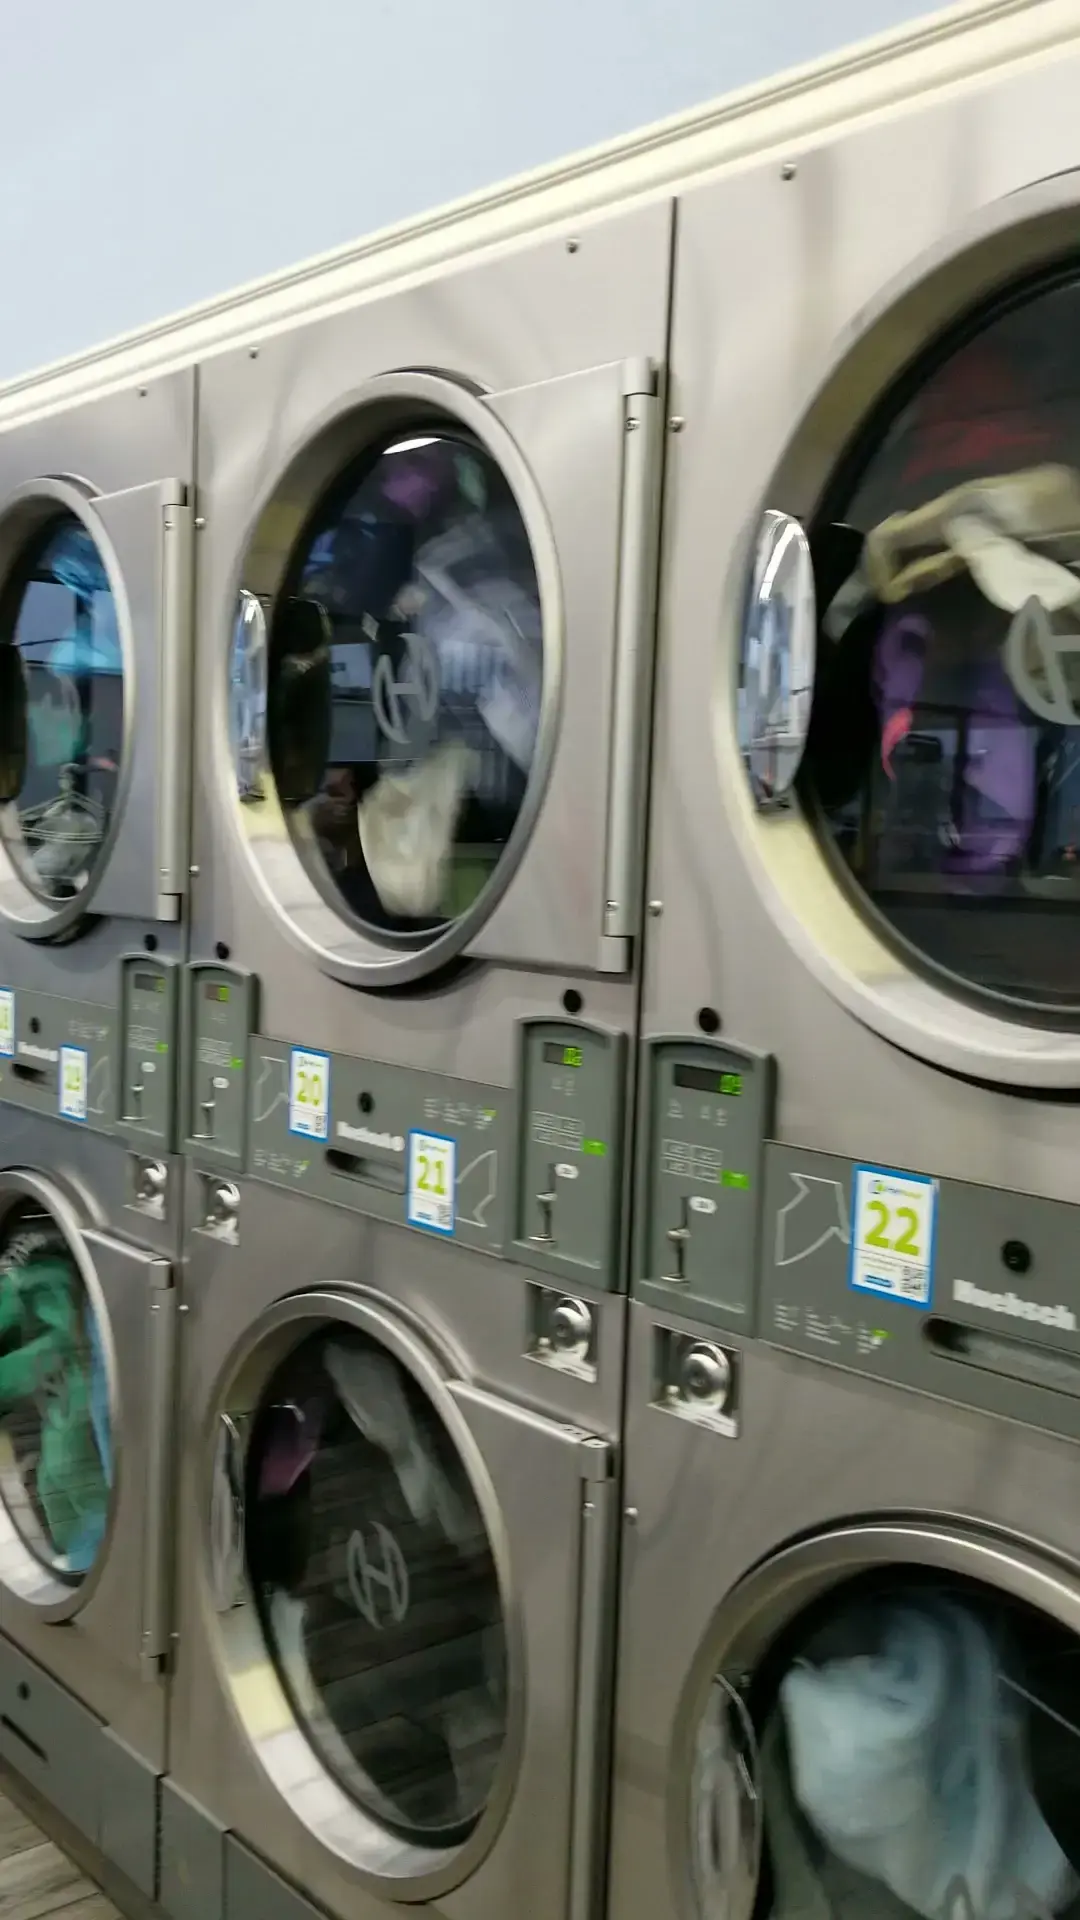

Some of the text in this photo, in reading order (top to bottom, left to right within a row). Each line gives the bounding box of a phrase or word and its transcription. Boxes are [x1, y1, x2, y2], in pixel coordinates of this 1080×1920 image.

[296, 1070, 323, 1107] 20
[416, 1154, 446, 1196] 21
[864, 1200, 919, 1257] 22
